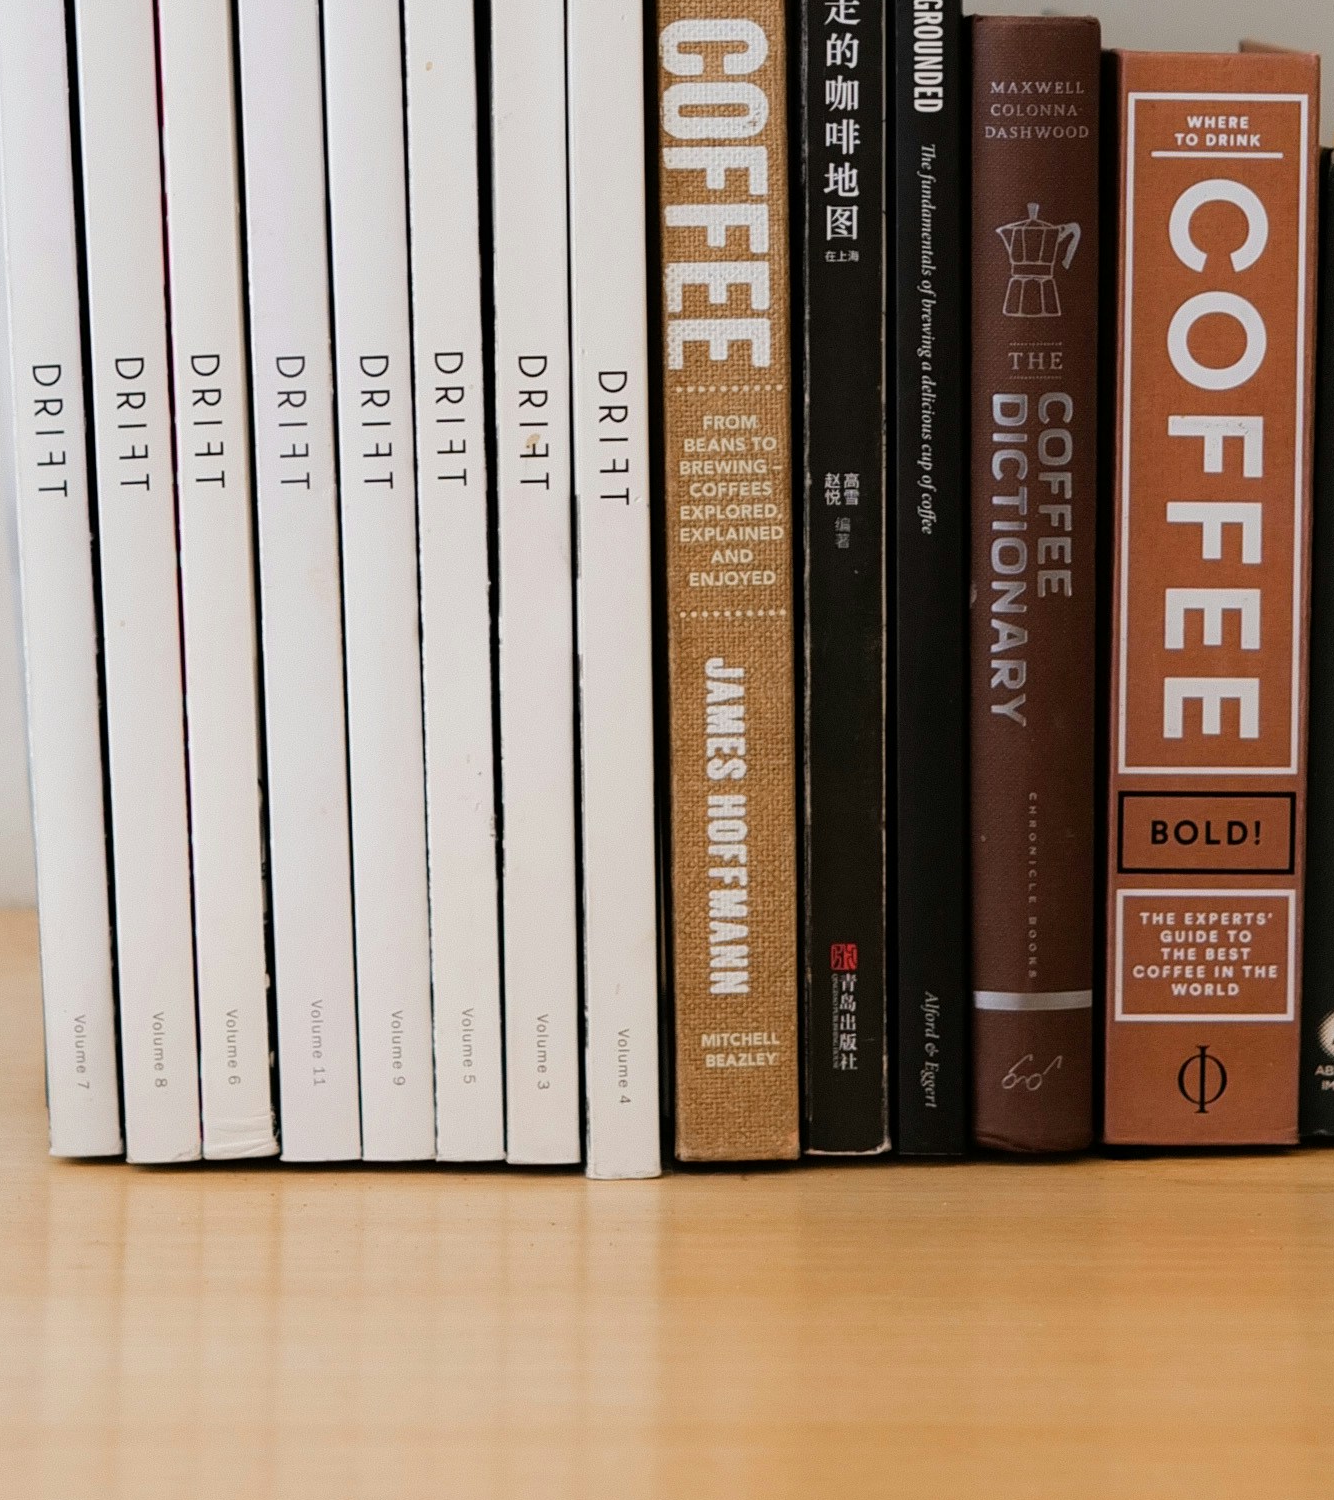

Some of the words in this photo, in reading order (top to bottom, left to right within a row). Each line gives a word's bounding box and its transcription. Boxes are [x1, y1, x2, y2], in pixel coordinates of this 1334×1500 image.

[990, 81, 1085, 95] MAXWELL
[985, 125, 1089, 139] DASHWOOD
[1187, 115, 1250, 130] WHERE
[1175, 132, 1199, 147] TO
[1205, 133, 1261, 147] DRINK
[920, 144, 937, 171] The
[659, 18, 771, 370] COFFEE
[916, 171, 937, 274] fundamentals
[824, 250, 860, 263] 在上海
[916, 273, 937, 297] of
[916, 298, 937, 359] brewing
[921, 361, 932, 371] a
[1008, 352, 1063, 371] THE
[433, 351, 468, 487] DRIFT
[921, 374, 937, 440] delicious
[31, 363, 68, 498] DRIFT
[114, 356, 151, 491] DRIFT
[190, 353, 226, 489] DRIFT
[275, 355, 311, 490] DRIFT
[359, 354, 394, 490] DRIFT
[517, 355, 550, 491] DRIFT
[703, 415, 758, 431] FROM
[597, 370, 630, 506] DRIFT
[684, 438, 746, 453] BEANS
[751, 437, 777, 452] TO
[680, 460, 767, 475] BREWING
[916, 444, 933, 471] cup
[1163, 178, 1268, 739] COFFEE
[690, 483, 772, 497] COFFEES
[917, 475, 937, 492] of
[1038, 391, 1073, 599] COFFEE
[681, 505, 783, 522] EXPLORED,
[917, 493, 937, 535] coffee
[681, 526, 784, 542] EXPLAINED
[711, 549, 753, 564] AND
[990, 394, 1028, 728] DICTIONARY
[689, 571, 776, 588] ENJOYED
[705, 658, 748, 781] JAMES
[1151, 820, 1261, 846] BOLD!
[1028, 792, 1038, 904] CHRONICLE
[707, 794, 749, 994] HOFFMANN
[1139, 912, 1175, 925] THE
[1028, 917, 1038, 979] BOOKS
[1160, 930, 1218, 944] GUIDE
[1227, 930, 1252, 943] TO
[1160, 948, 1197, 961] THE
[1205, 948, 1251, 961] BEST
[1132, 965, 1205, 979] COFFEE
[1214, 965, 1235, 979] IN
[1242, 965, 1278, 979] THE
[1171, 983, 1240, 997] WORLD
[839, 973, 858, 1071] 青岛出版社
[920, 991, 941, 1039] Alford
[152, 1011, 166, 1072] Volume
[225, 1008, 239, 1069] Volume
[310, 999, 324, 1059] Volume
[390, 1009, 404, 1070] Volume
[461, 1007, 475, 1068] Volume
[701, 1032, 780, 1047] MITCHELL
[73, 1014, 87, 1074] Volume
[536, 1013, 549, 1074] Volume
[924, 1042, 940, 1058] &
[617, 1028, 631, 1089] Volume
[705, 1053, 777, 1068] BEAZLEY
[77, 1081, 91, 1090] 7
[154, 1077, 168, 1088] 8
[227, 1074, 242, 1086] 6
[312, 1067, 327, 1086] 11
[392, 1075, 406, 1087] 9
[462, 1074, 477, 1085] 5
[536, 1080, 551, 1091] 3
[619, 1095, 632, 1104] 4
